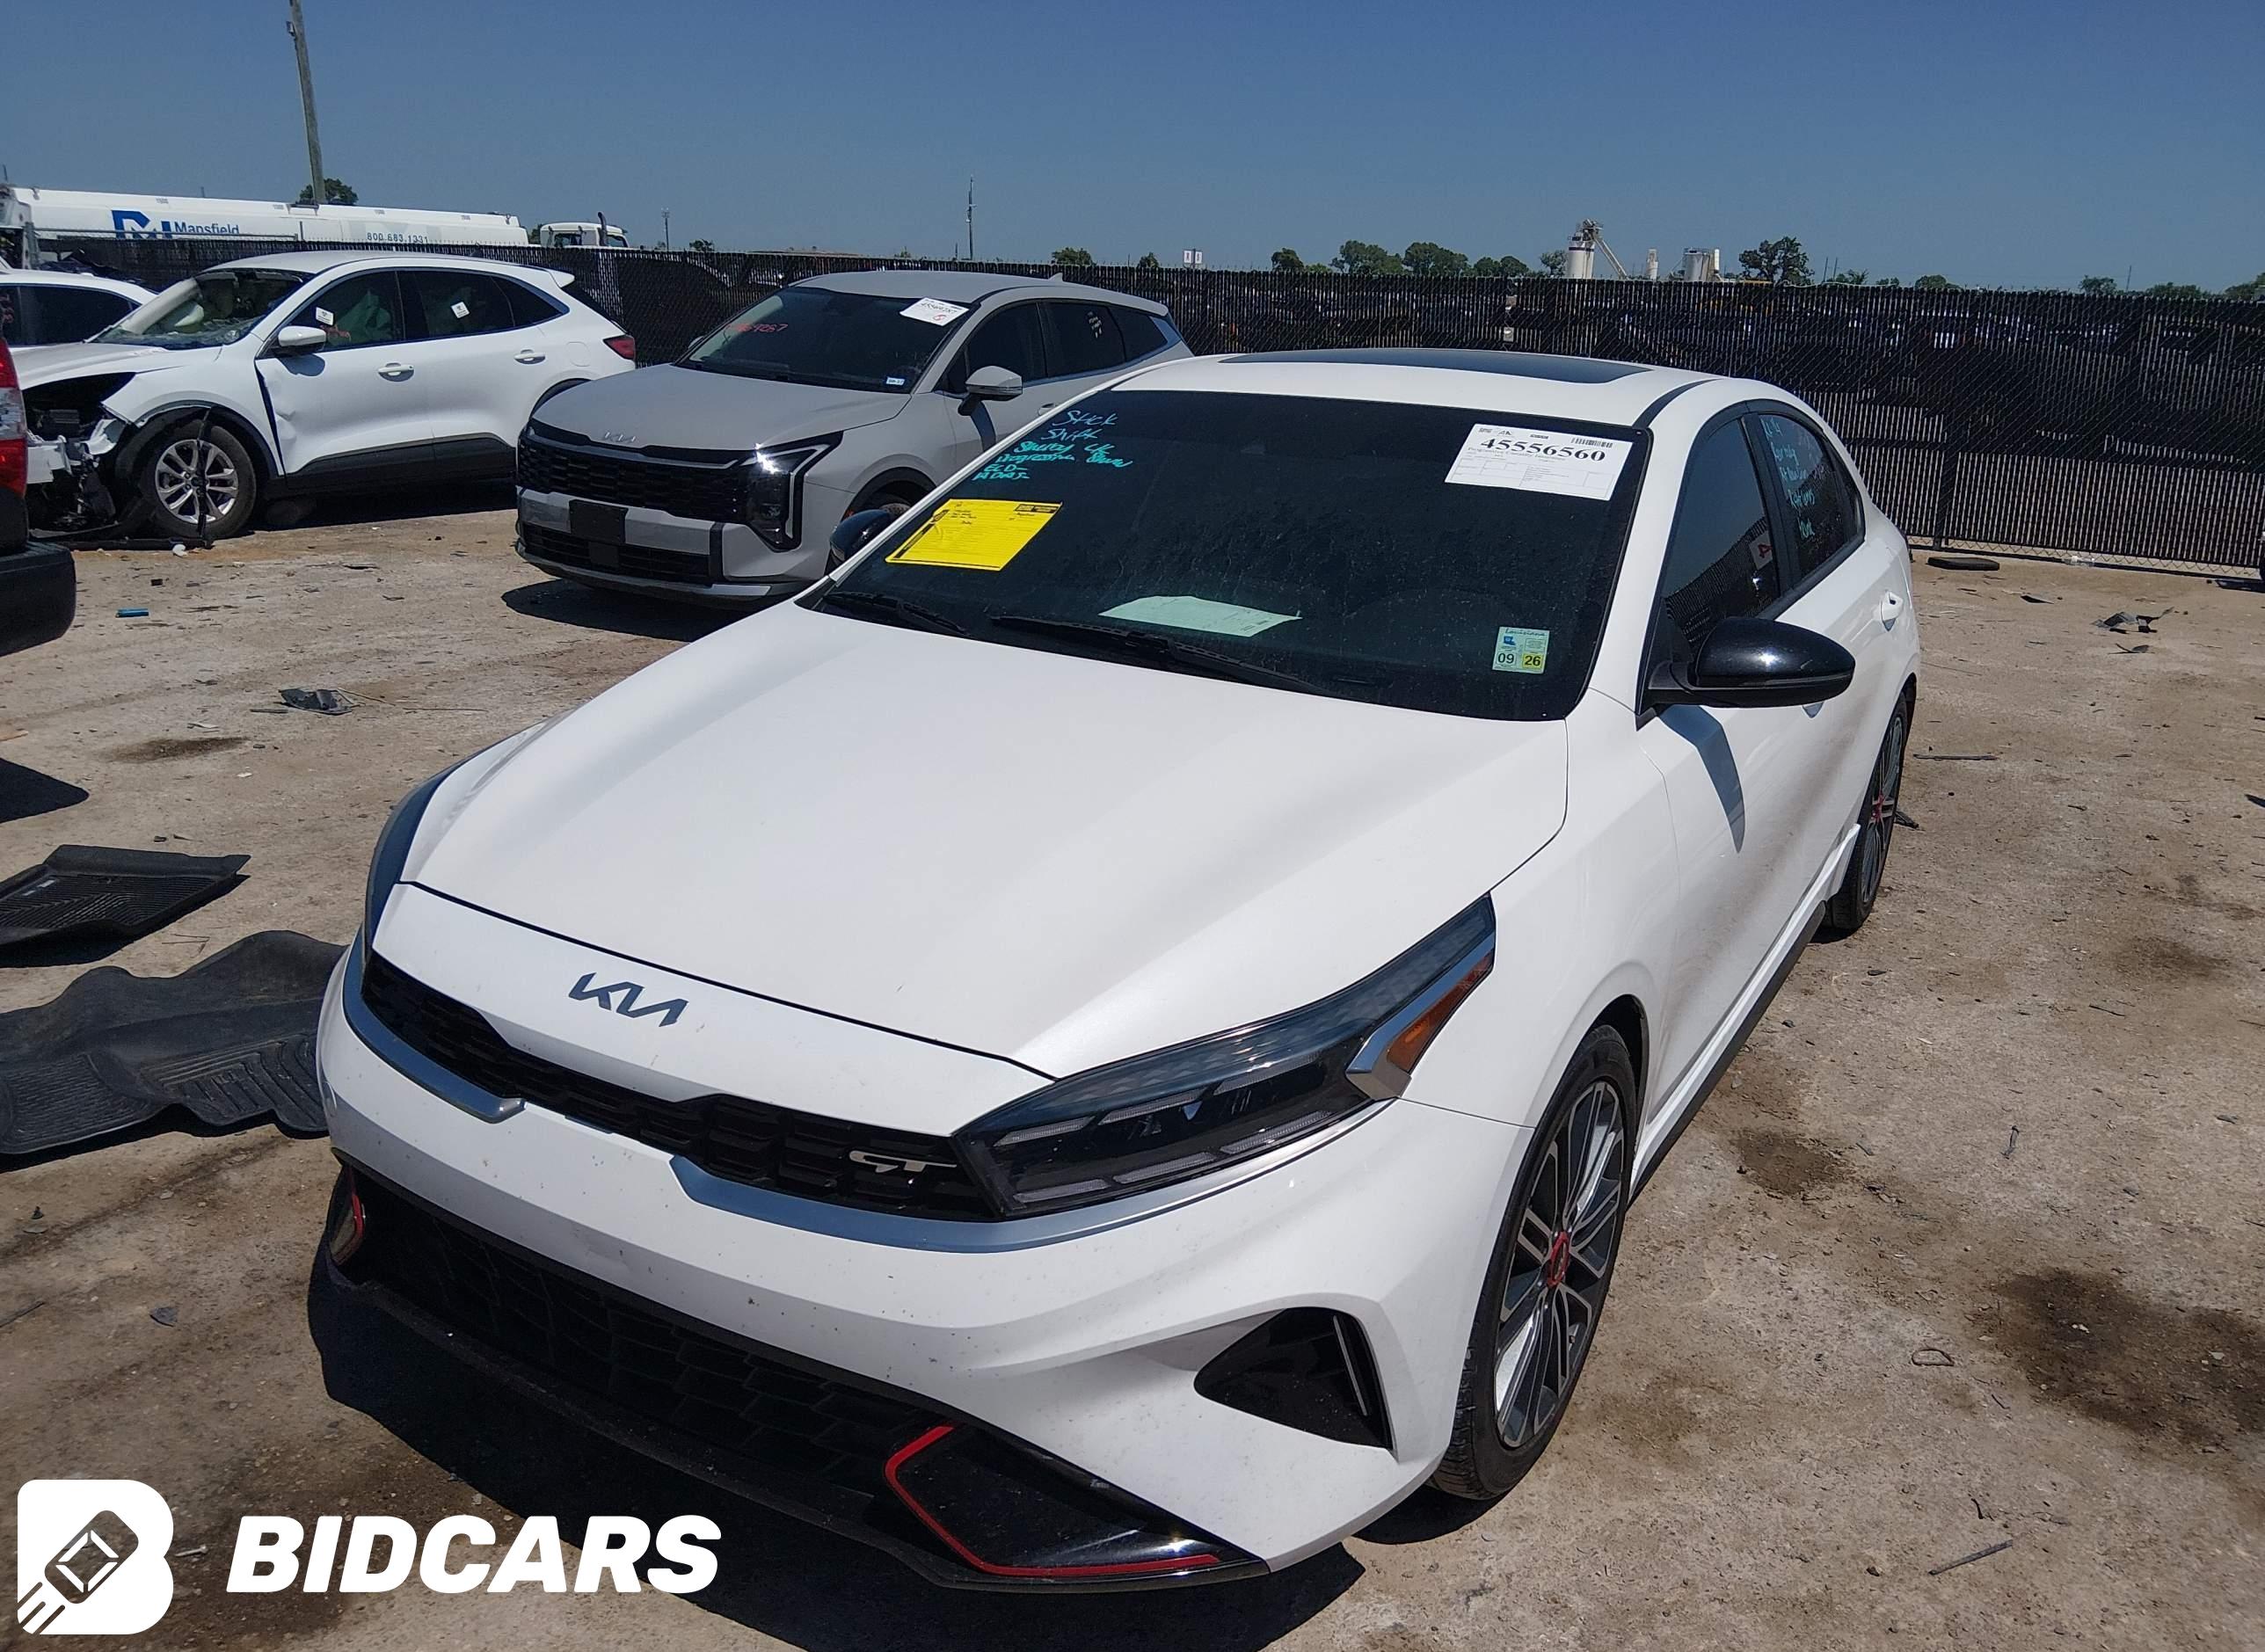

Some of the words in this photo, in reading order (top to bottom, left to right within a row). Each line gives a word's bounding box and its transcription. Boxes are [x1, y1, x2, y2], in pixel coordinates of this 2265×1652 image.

[175, 221, 239, 236] Mansfield
[1480, 438, 1606, 462] 45556560
[1497, 652, 1515, 664] 09
[1525, 655, 1540, 666] 26
[568, 972, 688, 1028] KIA
[849, 1149, 958, 1173] GT
